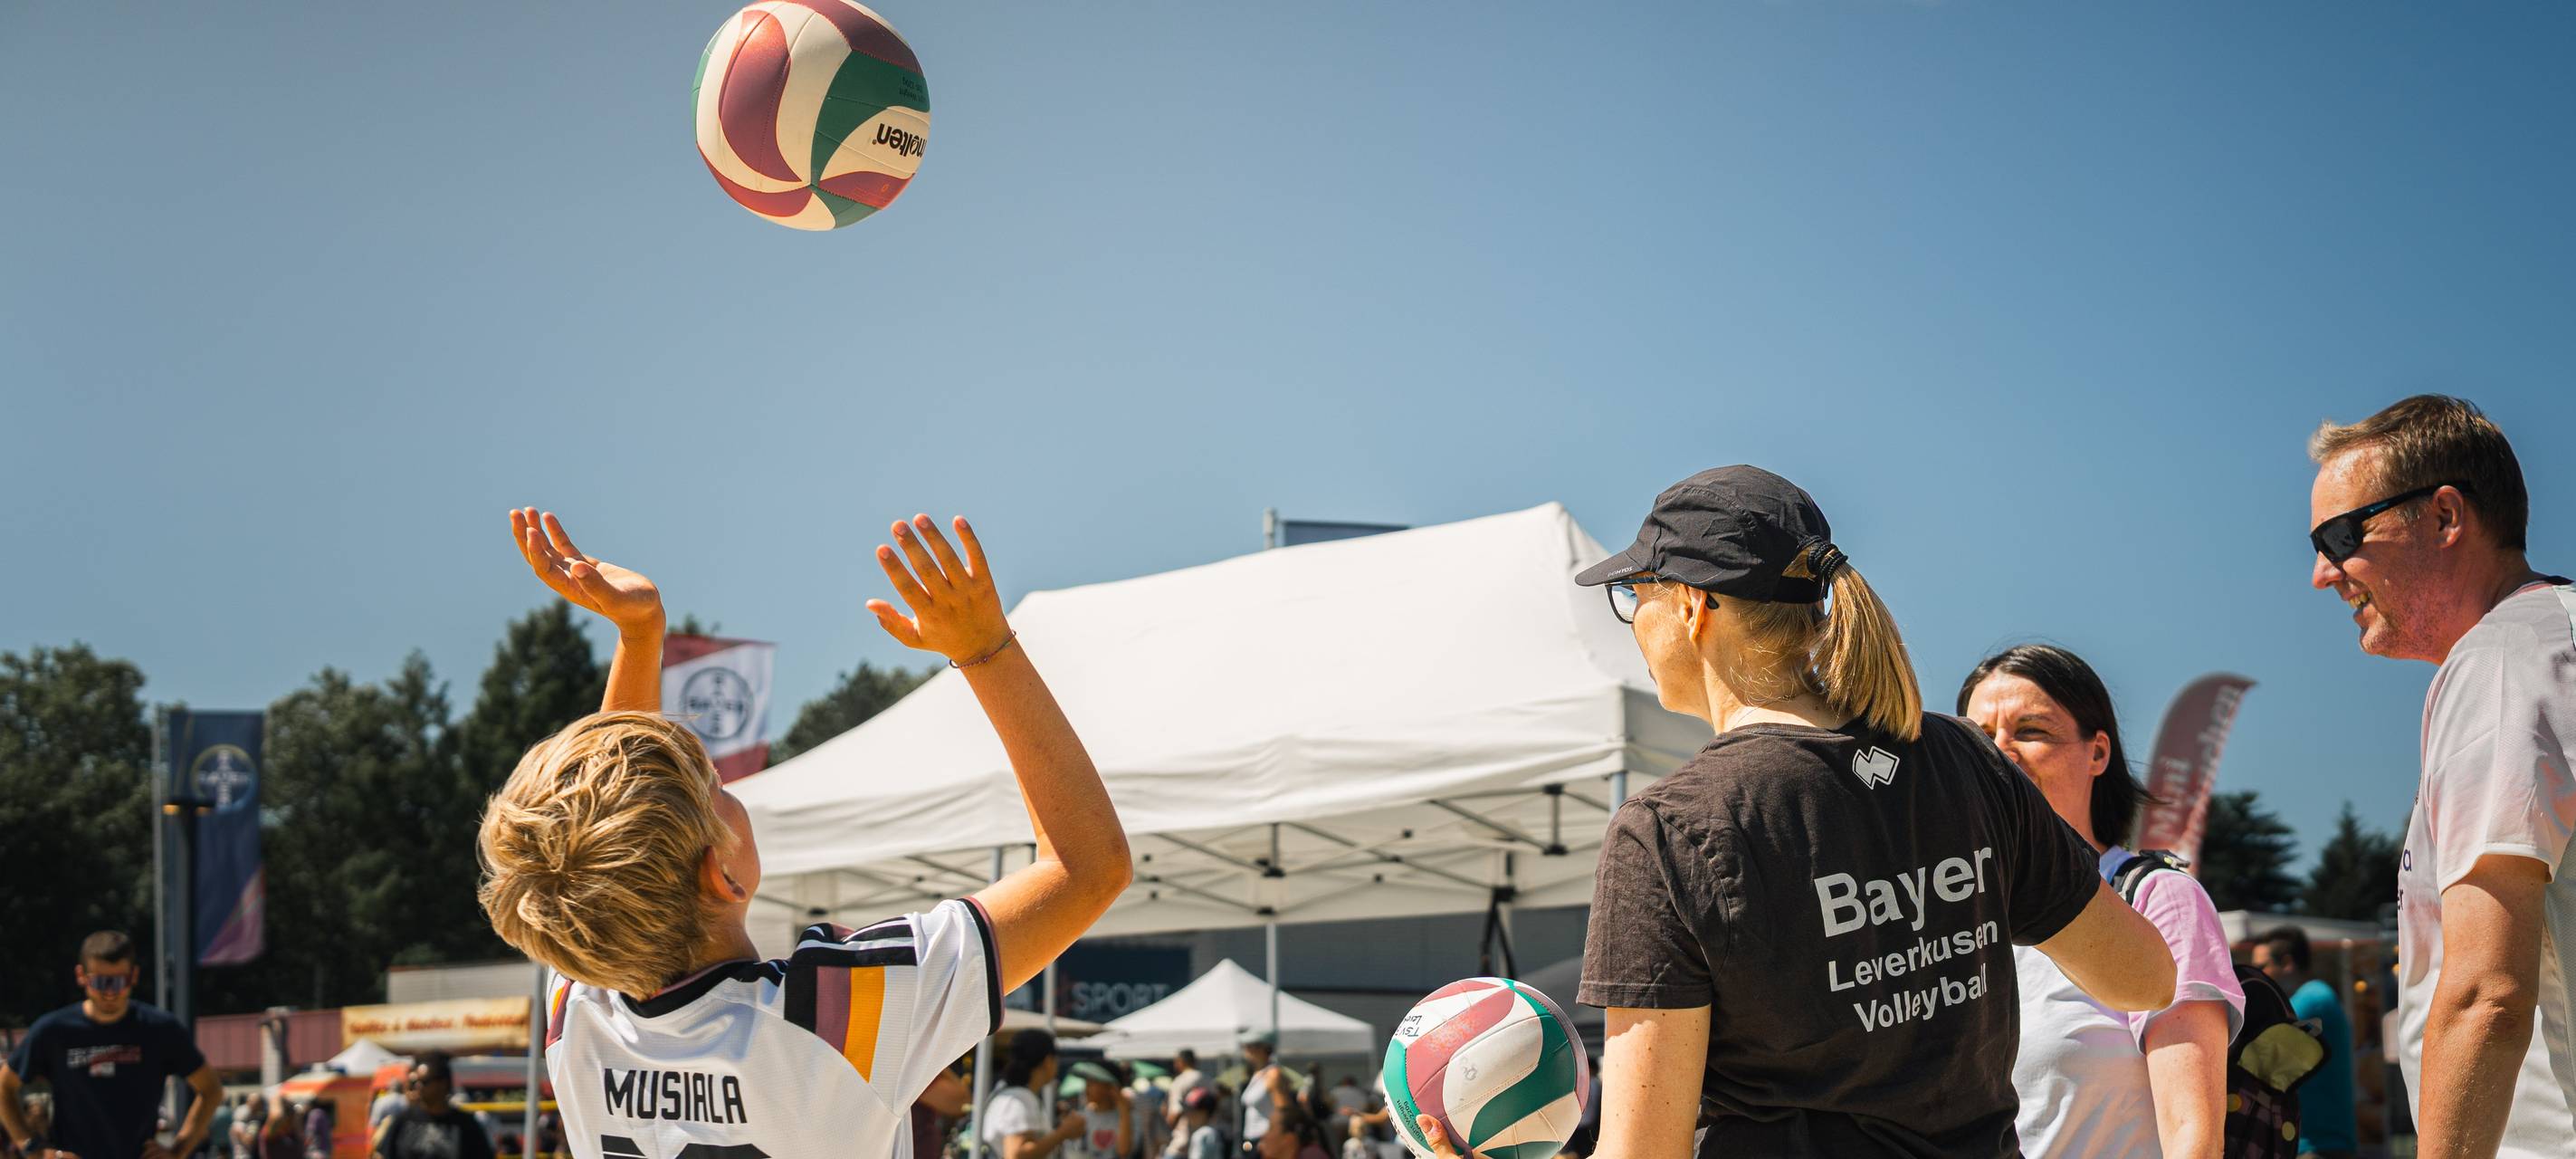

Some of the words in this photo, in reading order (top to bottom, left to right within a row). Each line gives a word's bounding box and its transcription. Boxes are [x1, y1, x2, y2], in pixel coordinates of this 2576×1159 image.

[1814, 847, 1991, 938] Bayer
[1828, 920, 1998, 992] Leverkusen
[1072, 982, 1170, 1015] SPORT
[1854, 963, 1987, 1032] Volleyball
[605, 1068, 748, 1124] MUSIALA
